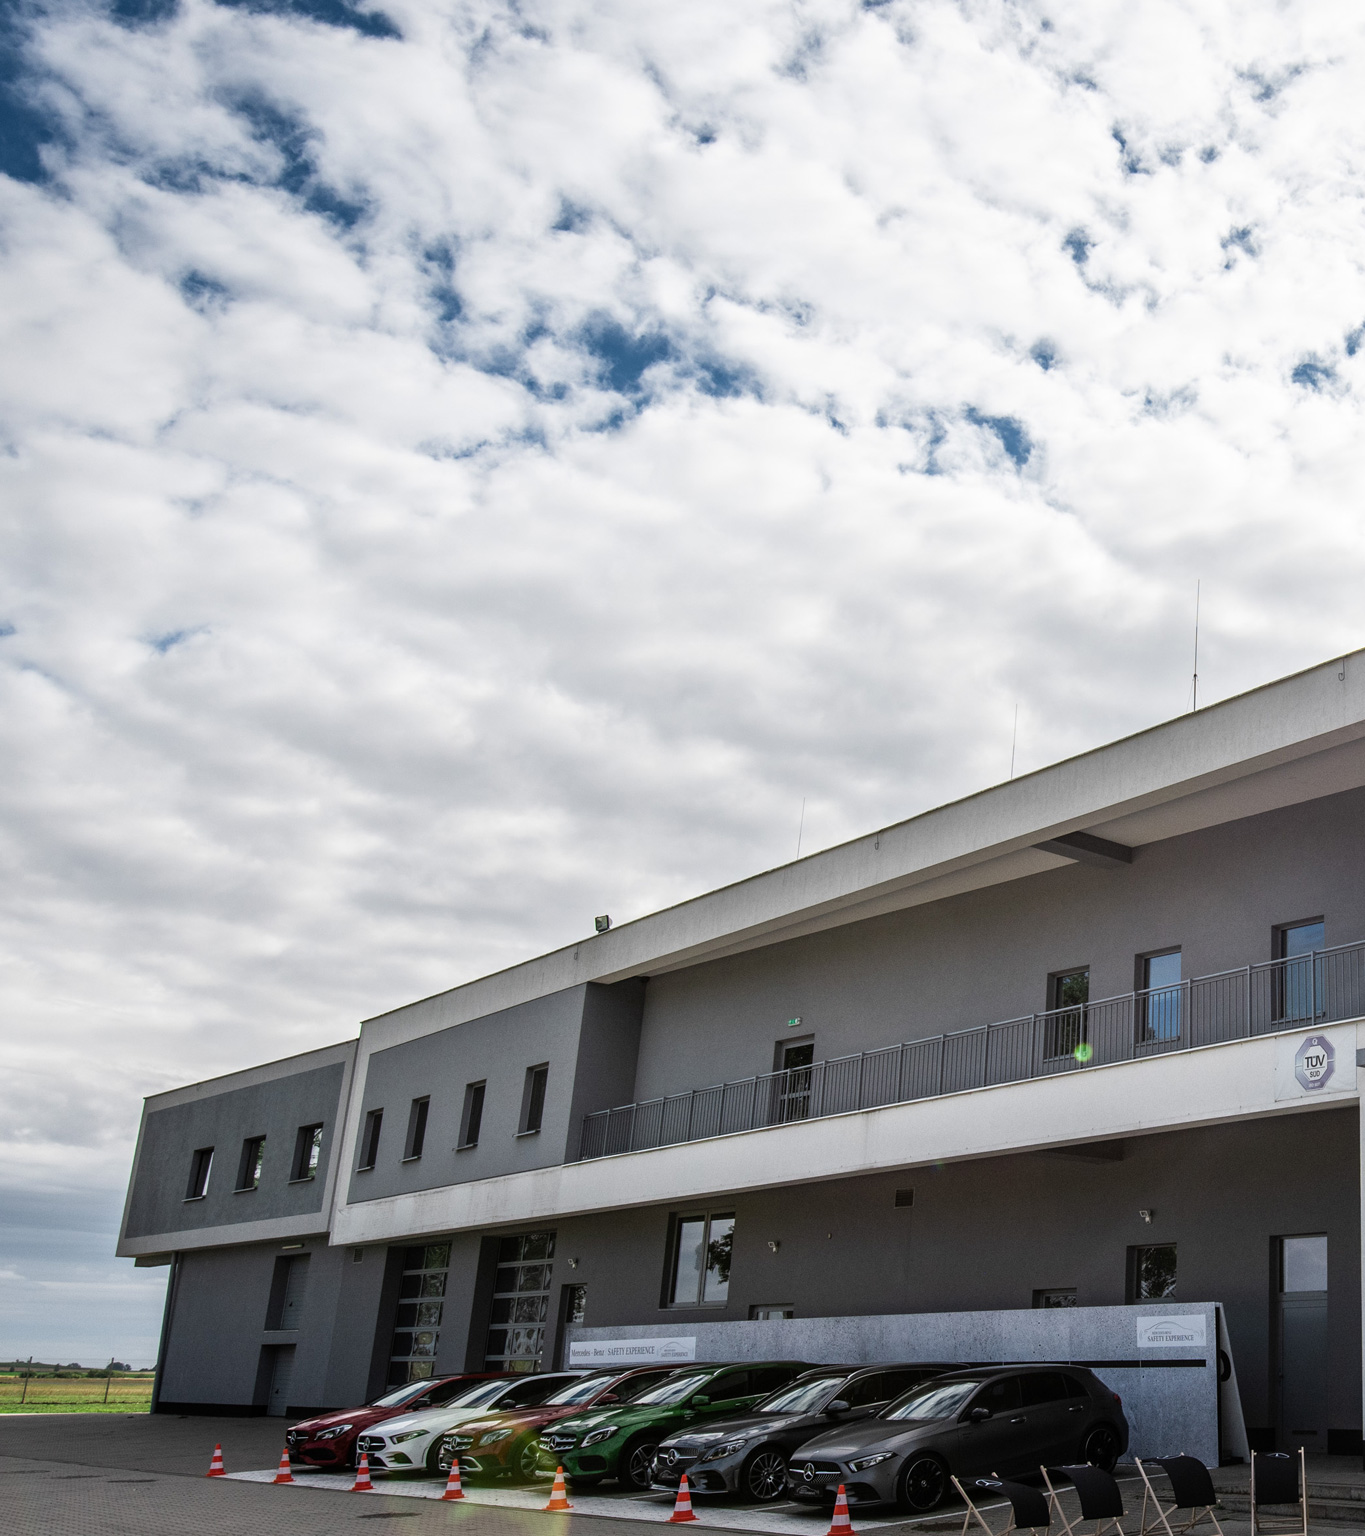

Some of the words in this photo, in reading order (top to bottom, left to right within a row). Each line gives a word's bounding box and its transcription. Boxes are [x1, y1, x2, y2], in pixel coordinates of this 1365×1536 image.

[1305, 1054, 1325, 1068] TÜV
[1310, 1070, 1320, 1078] SÜD
[571, 1349, 590, 1357] Mercedes
[608, 1347, 625, 1356] SAFETY
[626, 1346, 655, 1355] EXPERIENCE
